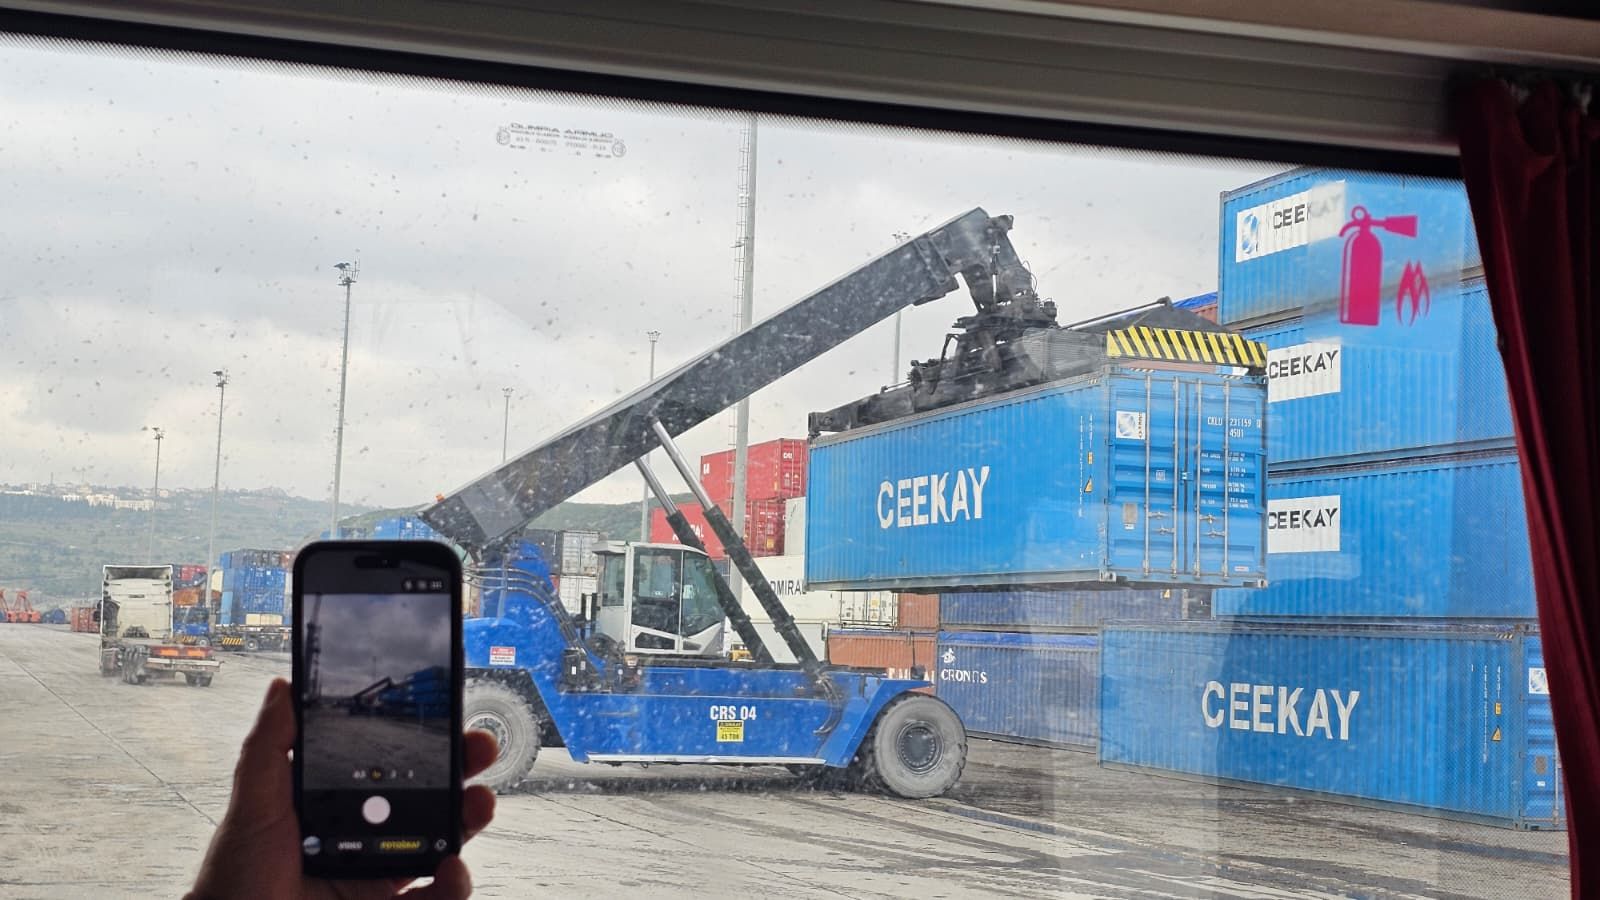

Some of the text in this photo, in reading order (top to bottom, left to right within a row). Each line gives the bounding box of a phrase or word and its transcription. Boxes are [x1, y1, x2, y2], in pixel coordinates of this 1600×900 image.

[1273, 194, 1341, 230] CEEAY
[1269, 350, 1338, 379] CEEKAY
[1229, 417, 1252, 428] 231159
[877, 466, 990, 529] CEEKAY
[1268, 508, 1338, 530] CEEKAY
[769, 580, 807, 596] DMIRAL
[710, 705, 757, 720] CRS 04
[1202, 680, 1360, 740] CEEKAY
